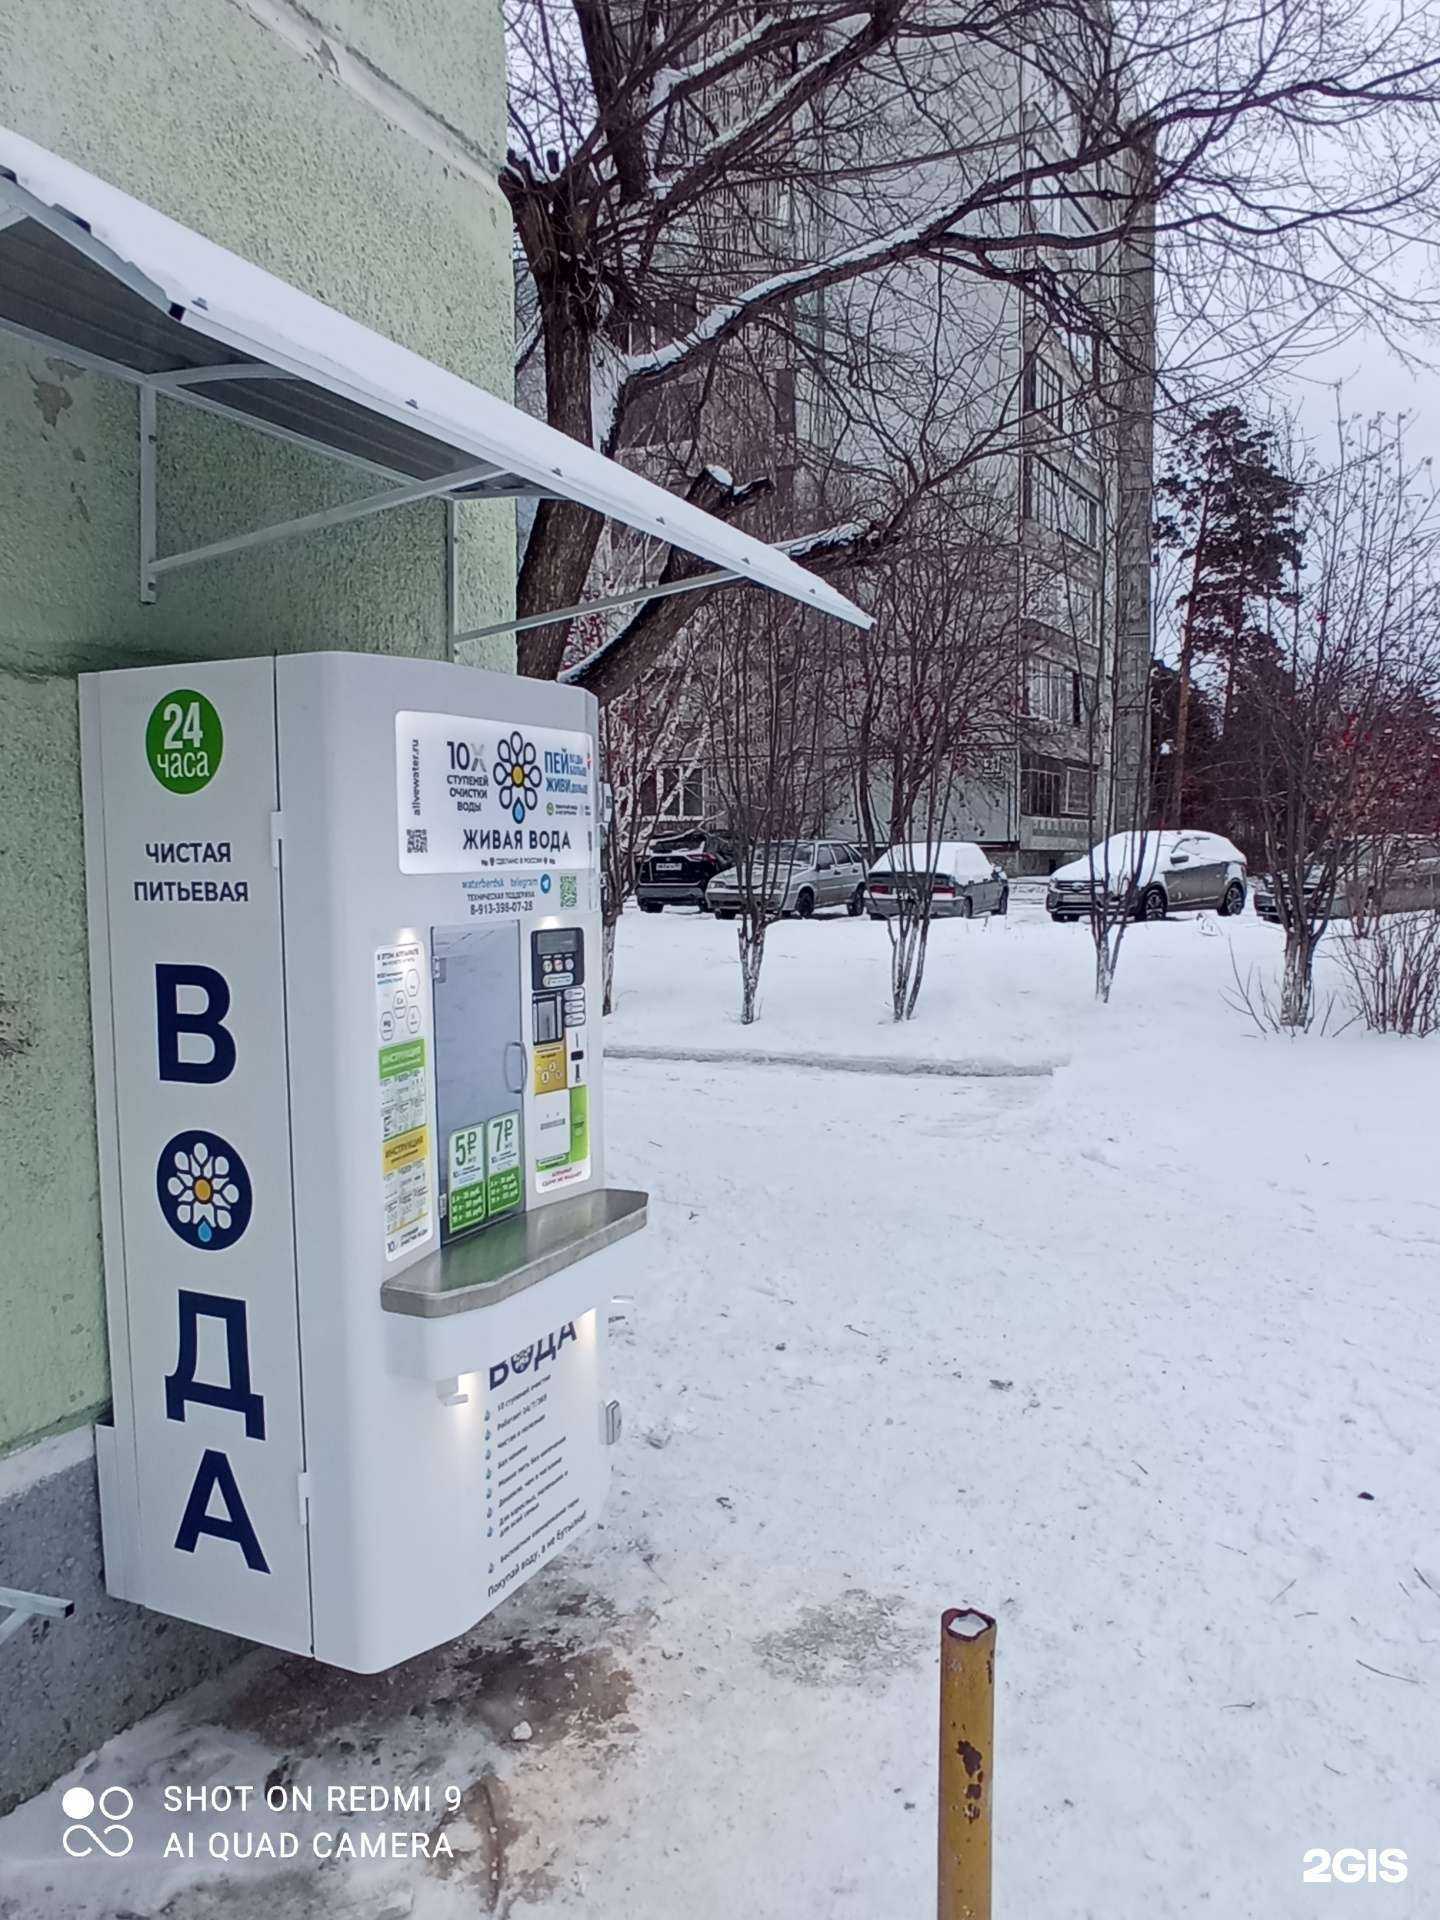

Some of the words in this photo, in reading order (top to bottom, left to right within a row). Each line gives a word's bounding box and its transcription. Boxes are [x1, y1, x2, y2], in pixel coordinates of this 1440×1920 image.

[163, 702, 203, 750] 24
[157, 750, 210, 778] часа
[544, 746, 569, 774] ПЕЙ
[447, 774, 489, 787] СТУПЕНЕЙ
[449, 787, 488, 799] ОЧИСТКИ
[457, 801, 482, 813] ВОДЫ
[462, 829, 523, 850] ЖИВАЯ
[529, 831, 572, 852] ВОДА
[146, 843, 231, 863] ЧИСТАЯ
[134, 881, 249, 902] ПИТЬЕВАЯ
